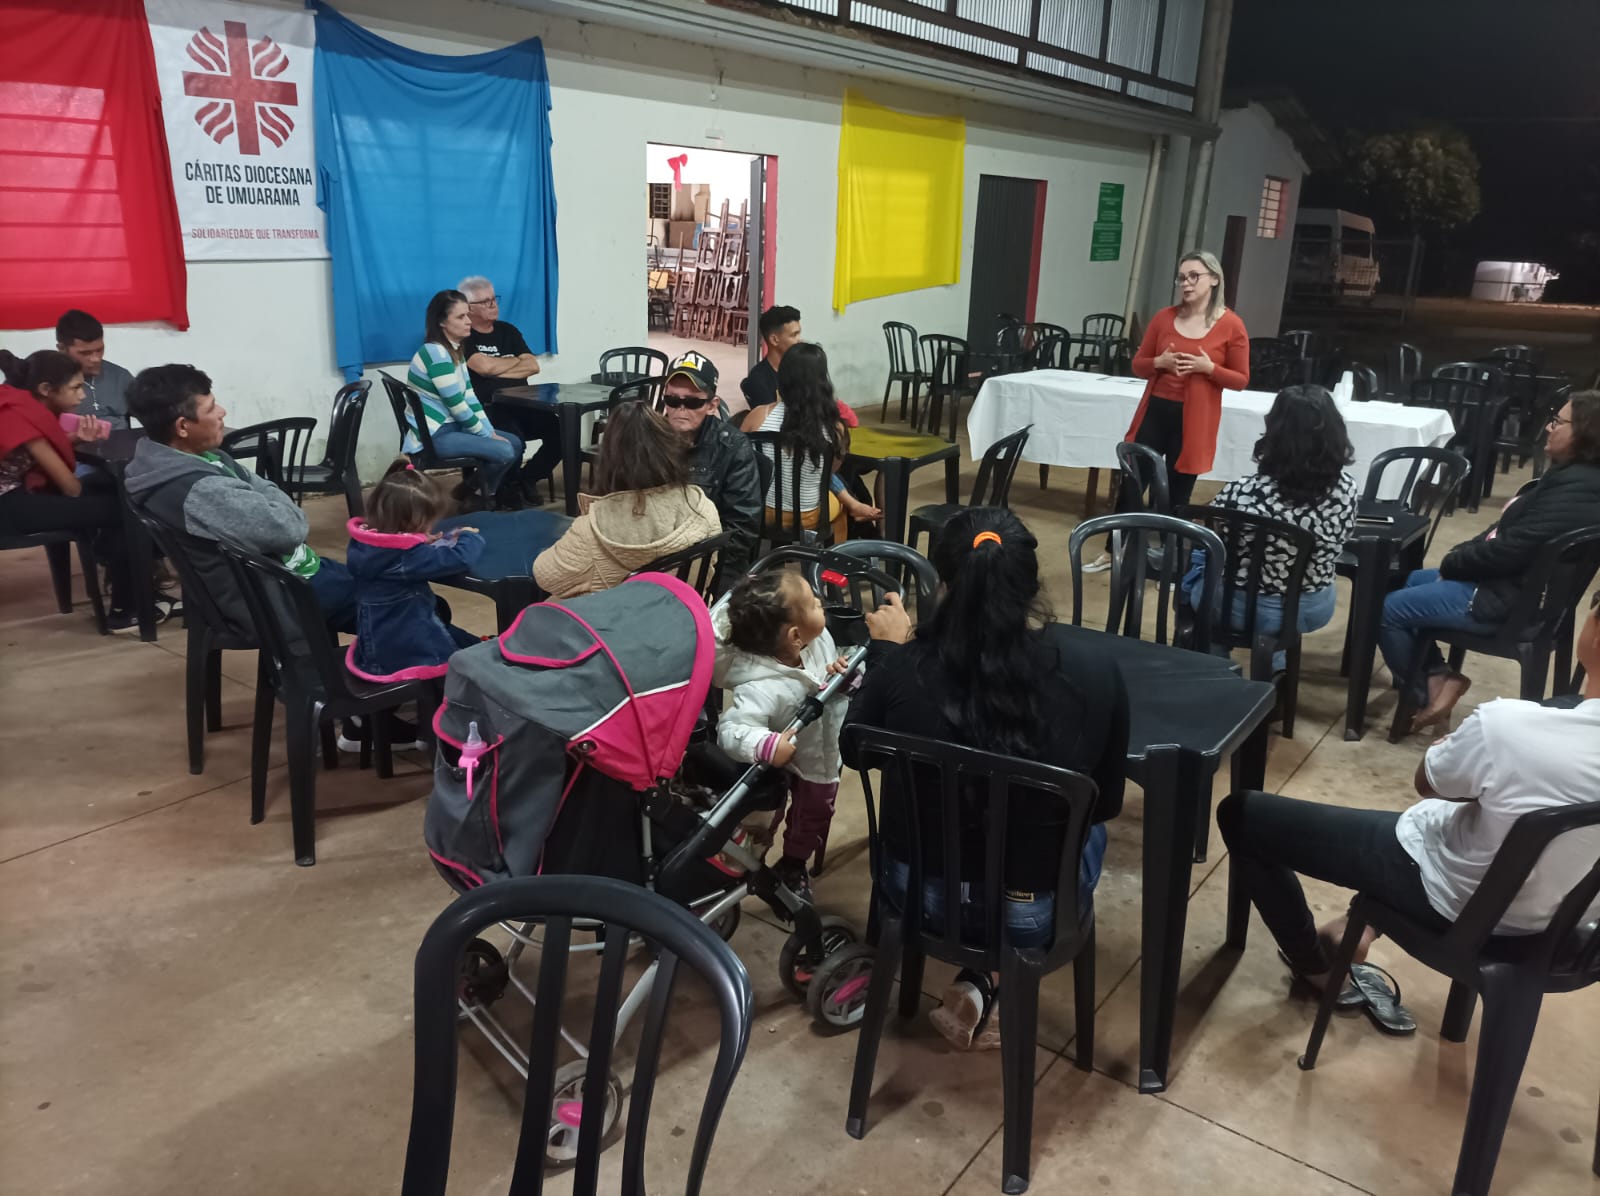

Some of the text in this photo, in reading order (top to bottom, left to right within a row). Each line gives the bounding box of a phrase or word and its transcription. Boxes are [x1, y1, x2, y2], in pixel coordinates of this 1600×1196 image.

[185, 159, 313, 186] CÁRITAS DIOCESANA
[205, 185, 301, 206] DE UMUARAMA
[191, 228, 319, 240] SOLIDARIEDADE QUE TRANSFORMA
[673, 353, 707, 371] CAT
